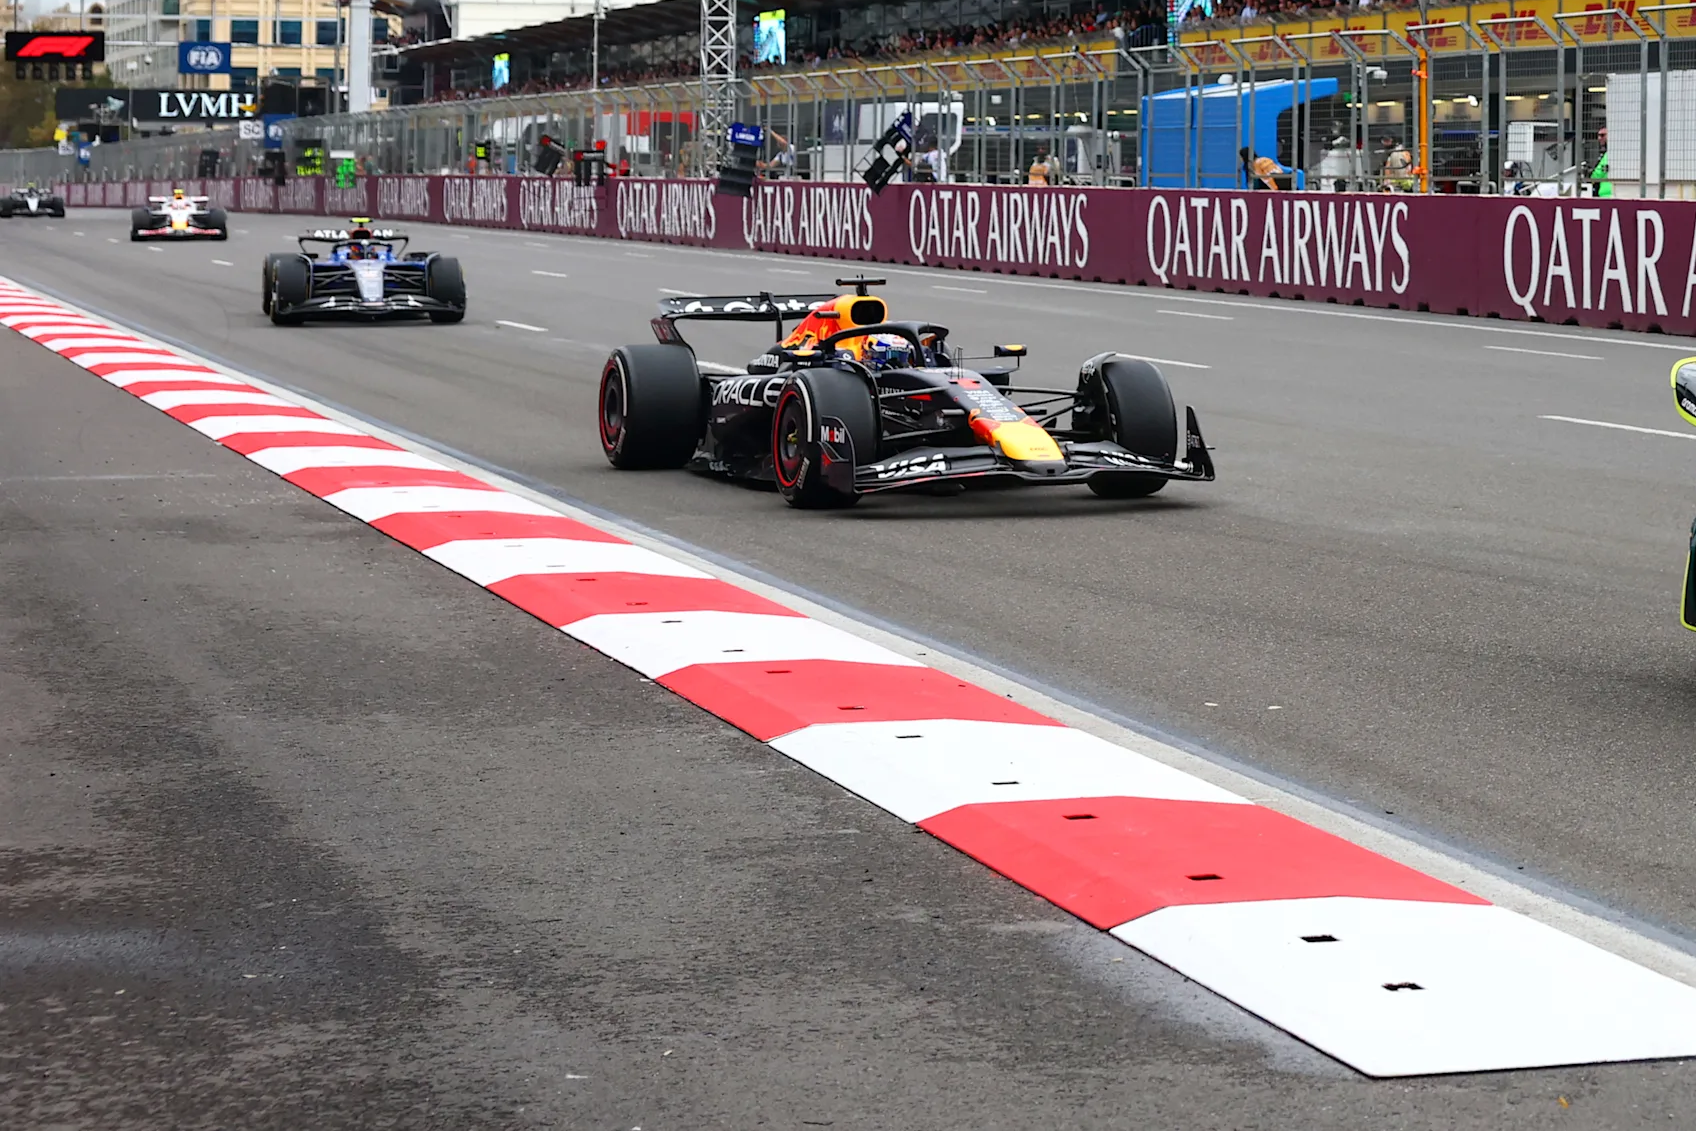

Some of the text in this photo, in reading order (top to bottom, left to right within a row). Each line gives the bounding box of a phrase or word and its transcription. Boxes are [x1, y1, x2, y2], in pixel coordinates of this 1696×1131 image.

[1584, 0, 1636, 34] DHL
[187, 48, 222, 68] FIA
[159, 92, 253, 118] LVMH
[244, 123, 260, 135] SC
[443, 178, 507, 222] QATAR AIRWAYS
[519, 180, 598, 229] QATAR AIRWAYS
[617, 181, 716, 241] QATAR AIRWAYS
[313, 229, 393, 239] ATLAAN
[743, 185, 873, 251] QATAR AIRWAYS
[909, 189, 1089, 268] QATAR AIRWAYS
[1147, 195, 1410, 294] QATAR AIRWAYS
[1504, 205, 1669, 317] QATAR
[712, 378, 785, 407] ORACLE
[821, 426, 846, 444] Mobil
[870, 453, 947, 479] VISA
